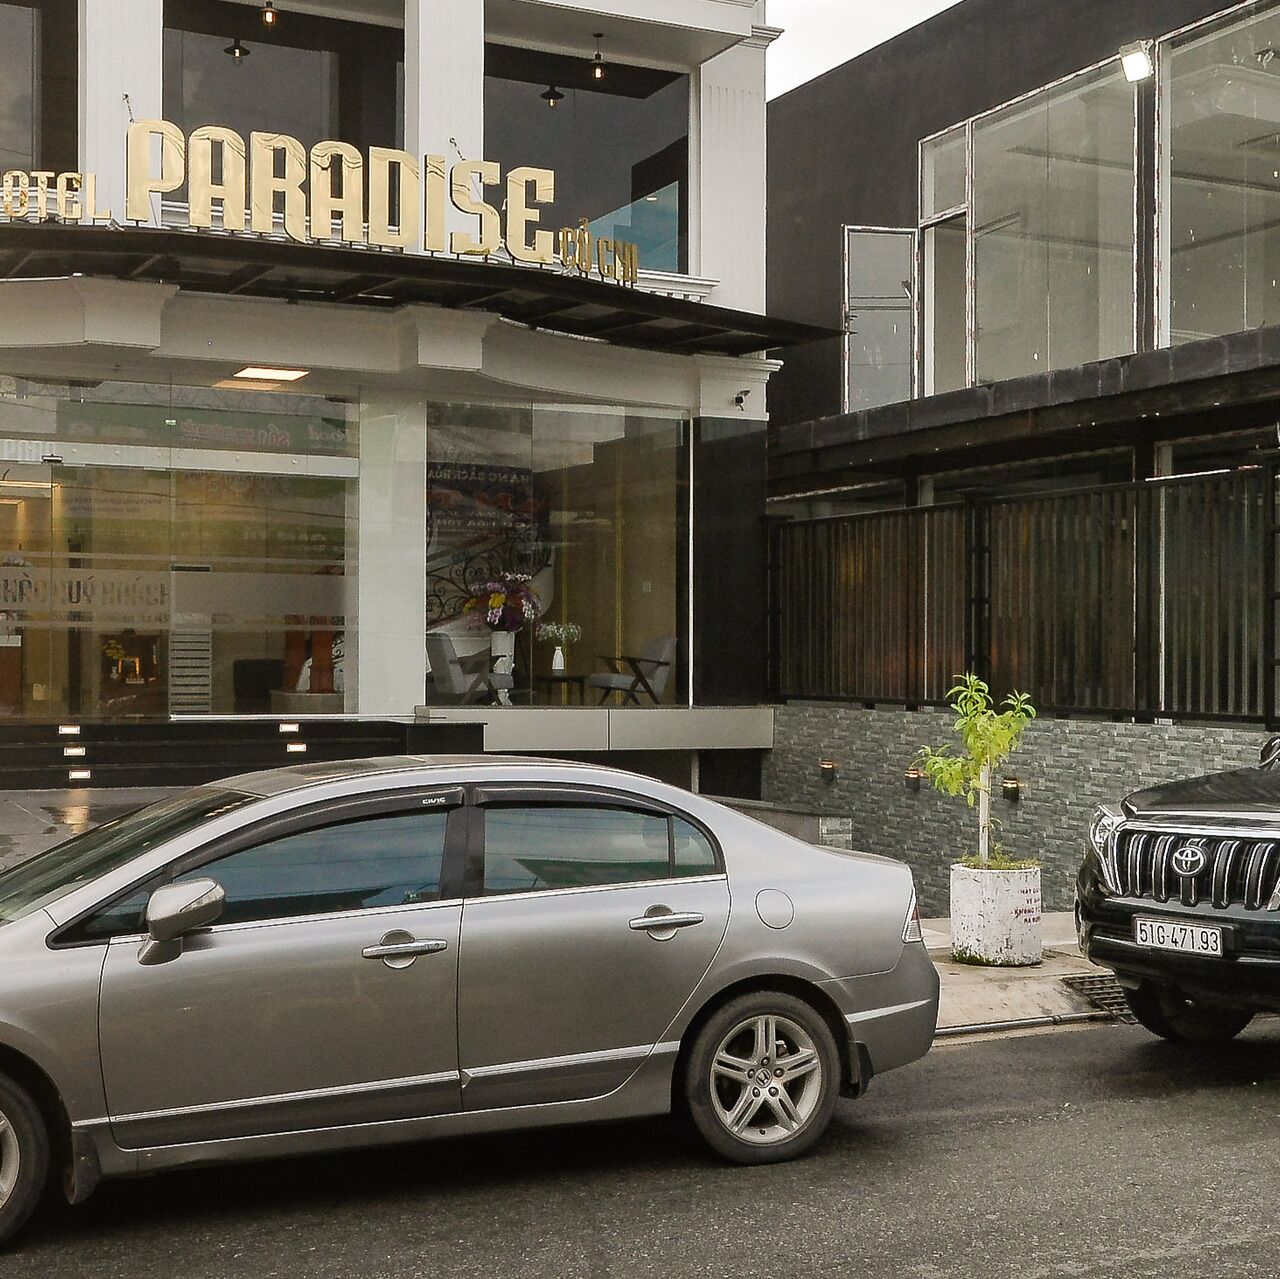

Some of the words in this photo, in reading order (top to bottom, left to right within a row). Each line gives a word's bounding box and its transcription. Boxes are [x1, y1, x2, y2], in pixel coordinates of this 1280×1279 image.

[126, 119, 555, 264] PARADISE
[597, 237, 638, 284] CHI
[1139, 922, 1219, 952] 51G-471.93
